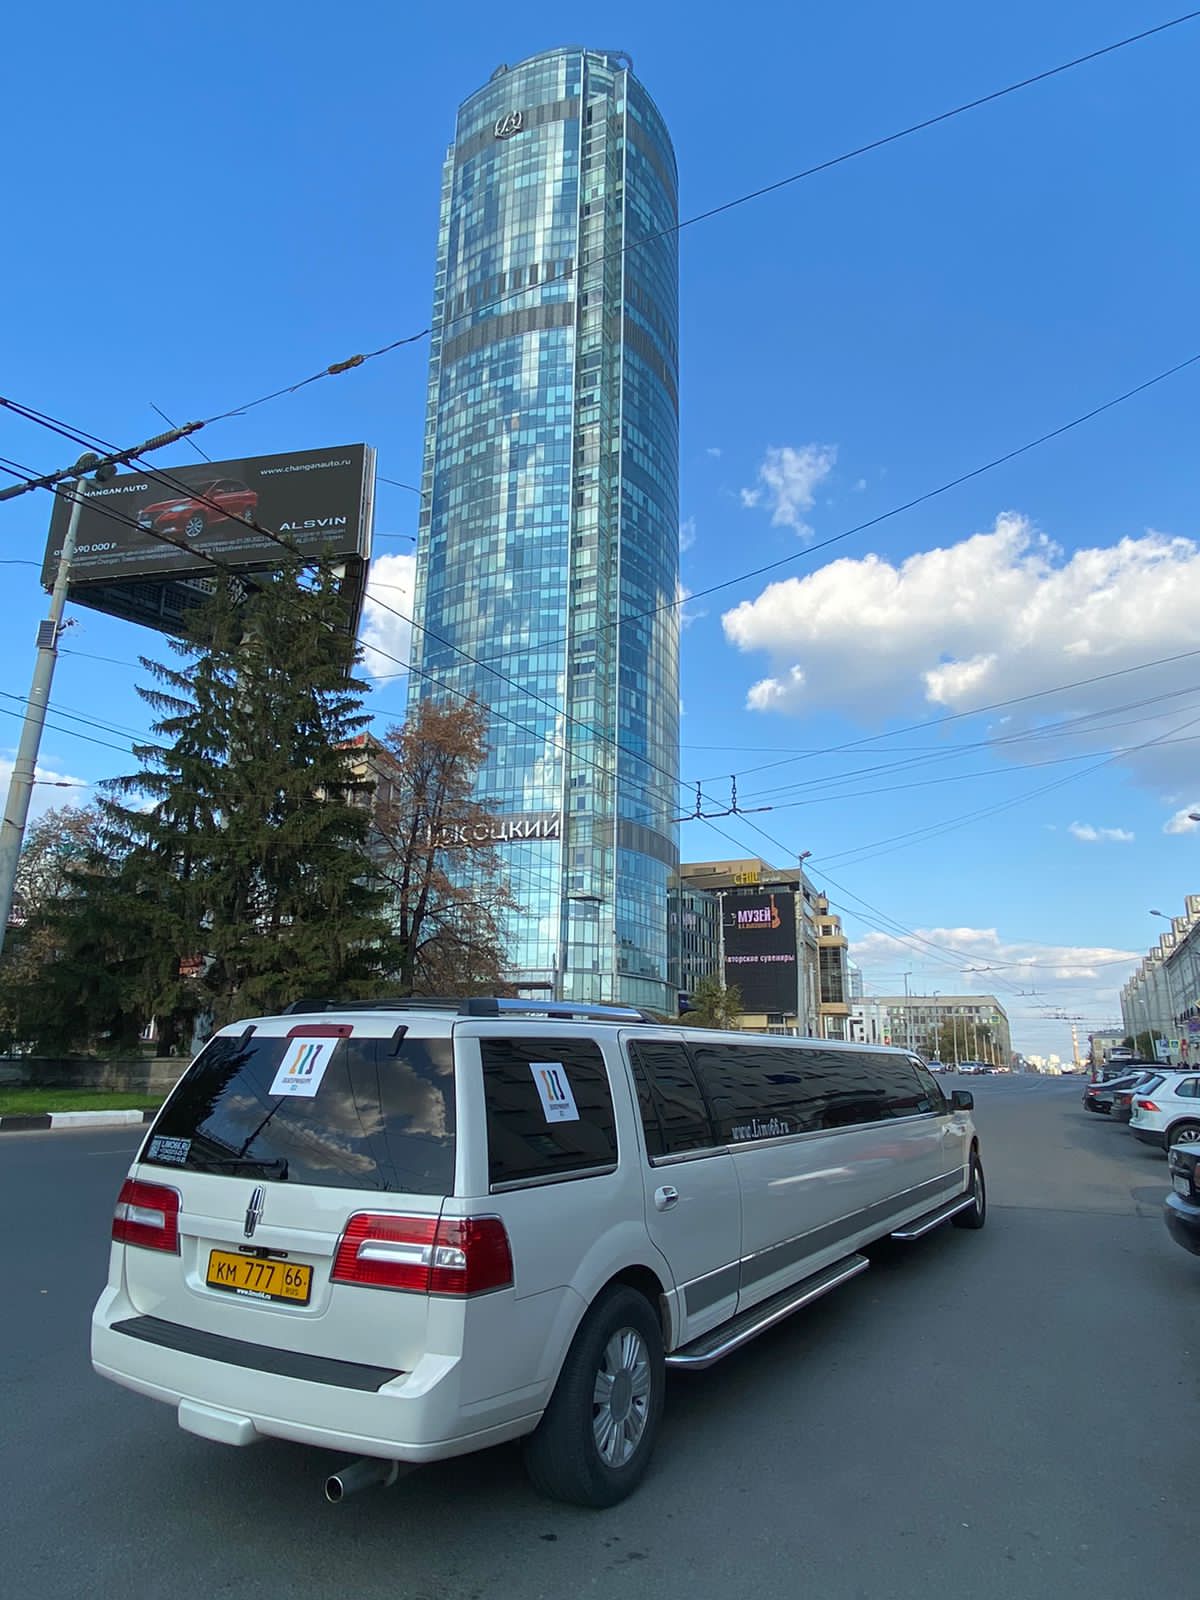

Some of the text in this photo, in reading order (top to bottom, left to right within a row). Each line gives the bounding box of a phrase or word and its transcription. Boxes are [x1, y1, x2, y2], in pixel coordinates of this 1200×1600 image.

[260, 459, 351, 475] www.changanauto.ru
[83, 483, 148, 498] HANGAN AUTO
[279, 516, 347, 531] ALSVIN
[91, 543, 110, 551] 000
[737, 907, 771, 922] МУЗЕЙ
[244, 1261, 275, 1288] 777
[285, 1268, 302, 1287] 66
